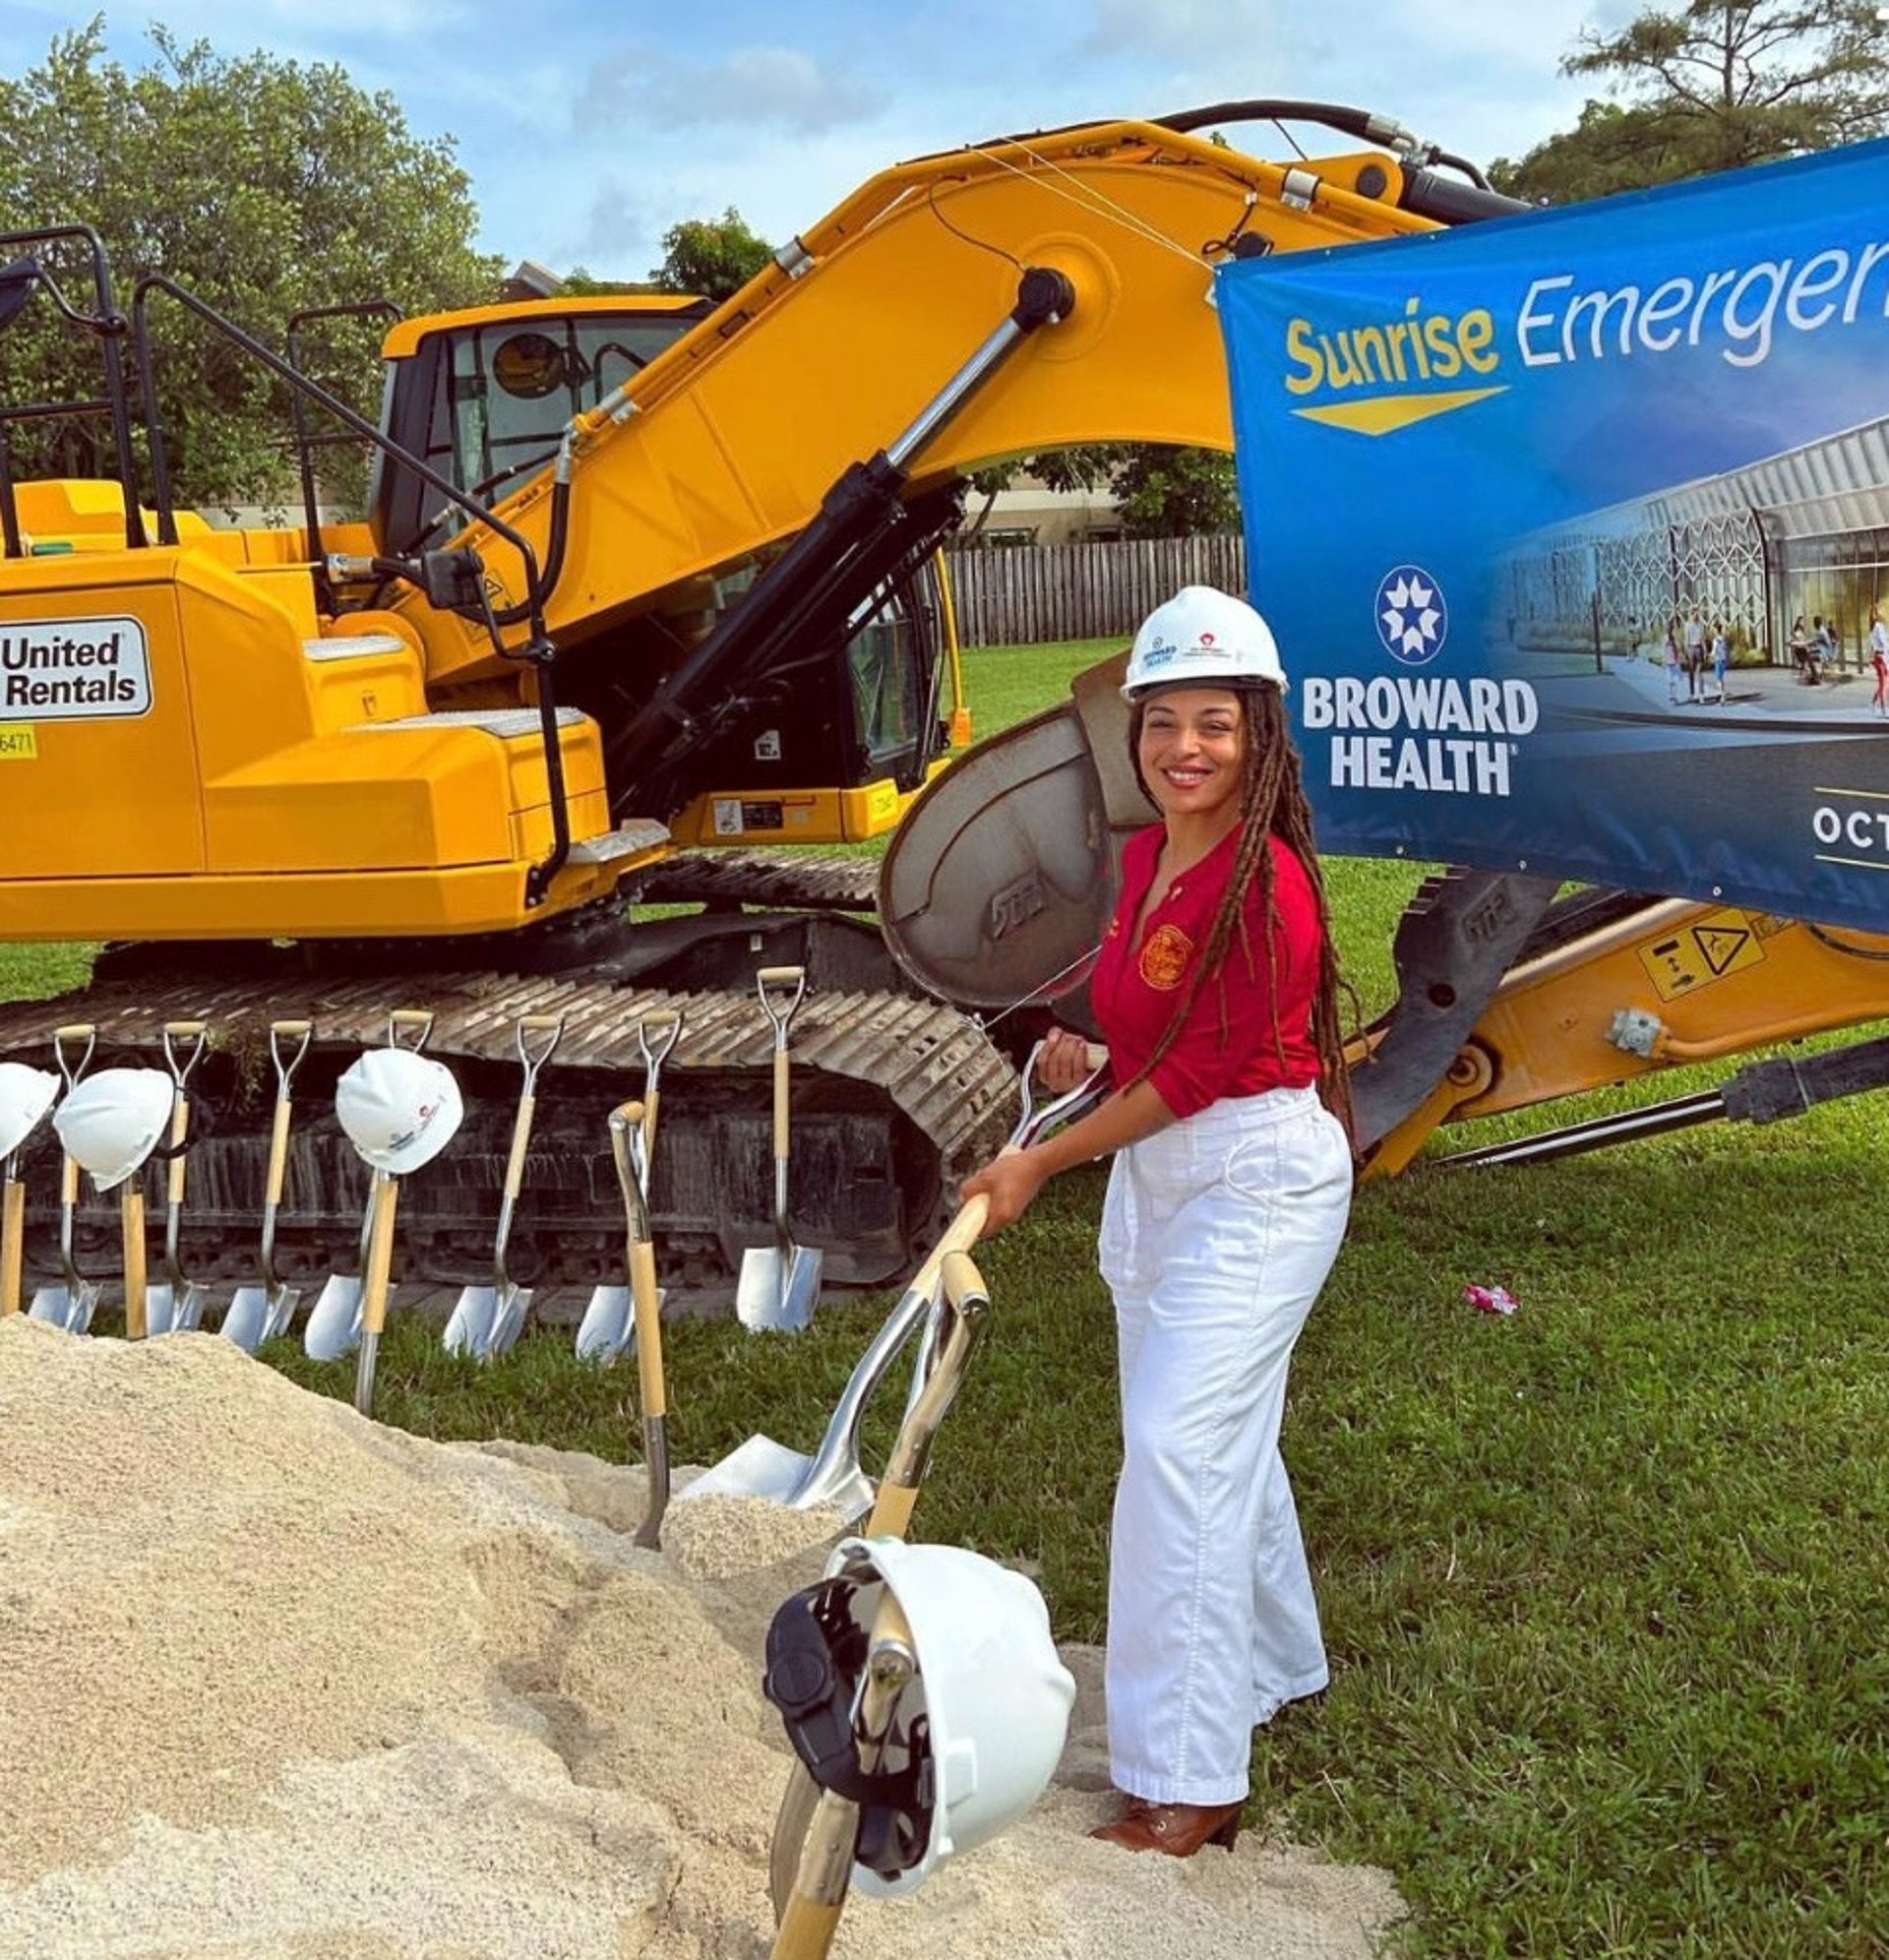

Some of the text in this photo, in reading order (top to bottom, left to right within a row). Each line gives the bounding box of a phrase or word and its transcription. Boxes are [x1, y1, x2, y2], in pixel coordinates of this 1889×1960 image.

[1285, 297, 1498, 394] Sunrise
[2, 633, 120, 670] United
[1143, 645, 1178, 661] OWARD
[6, 670, 136, 705] Rentals
[1304, 676, 1539, 735] BROWARD
[1331, 736, 1510, 796] HEALTH
